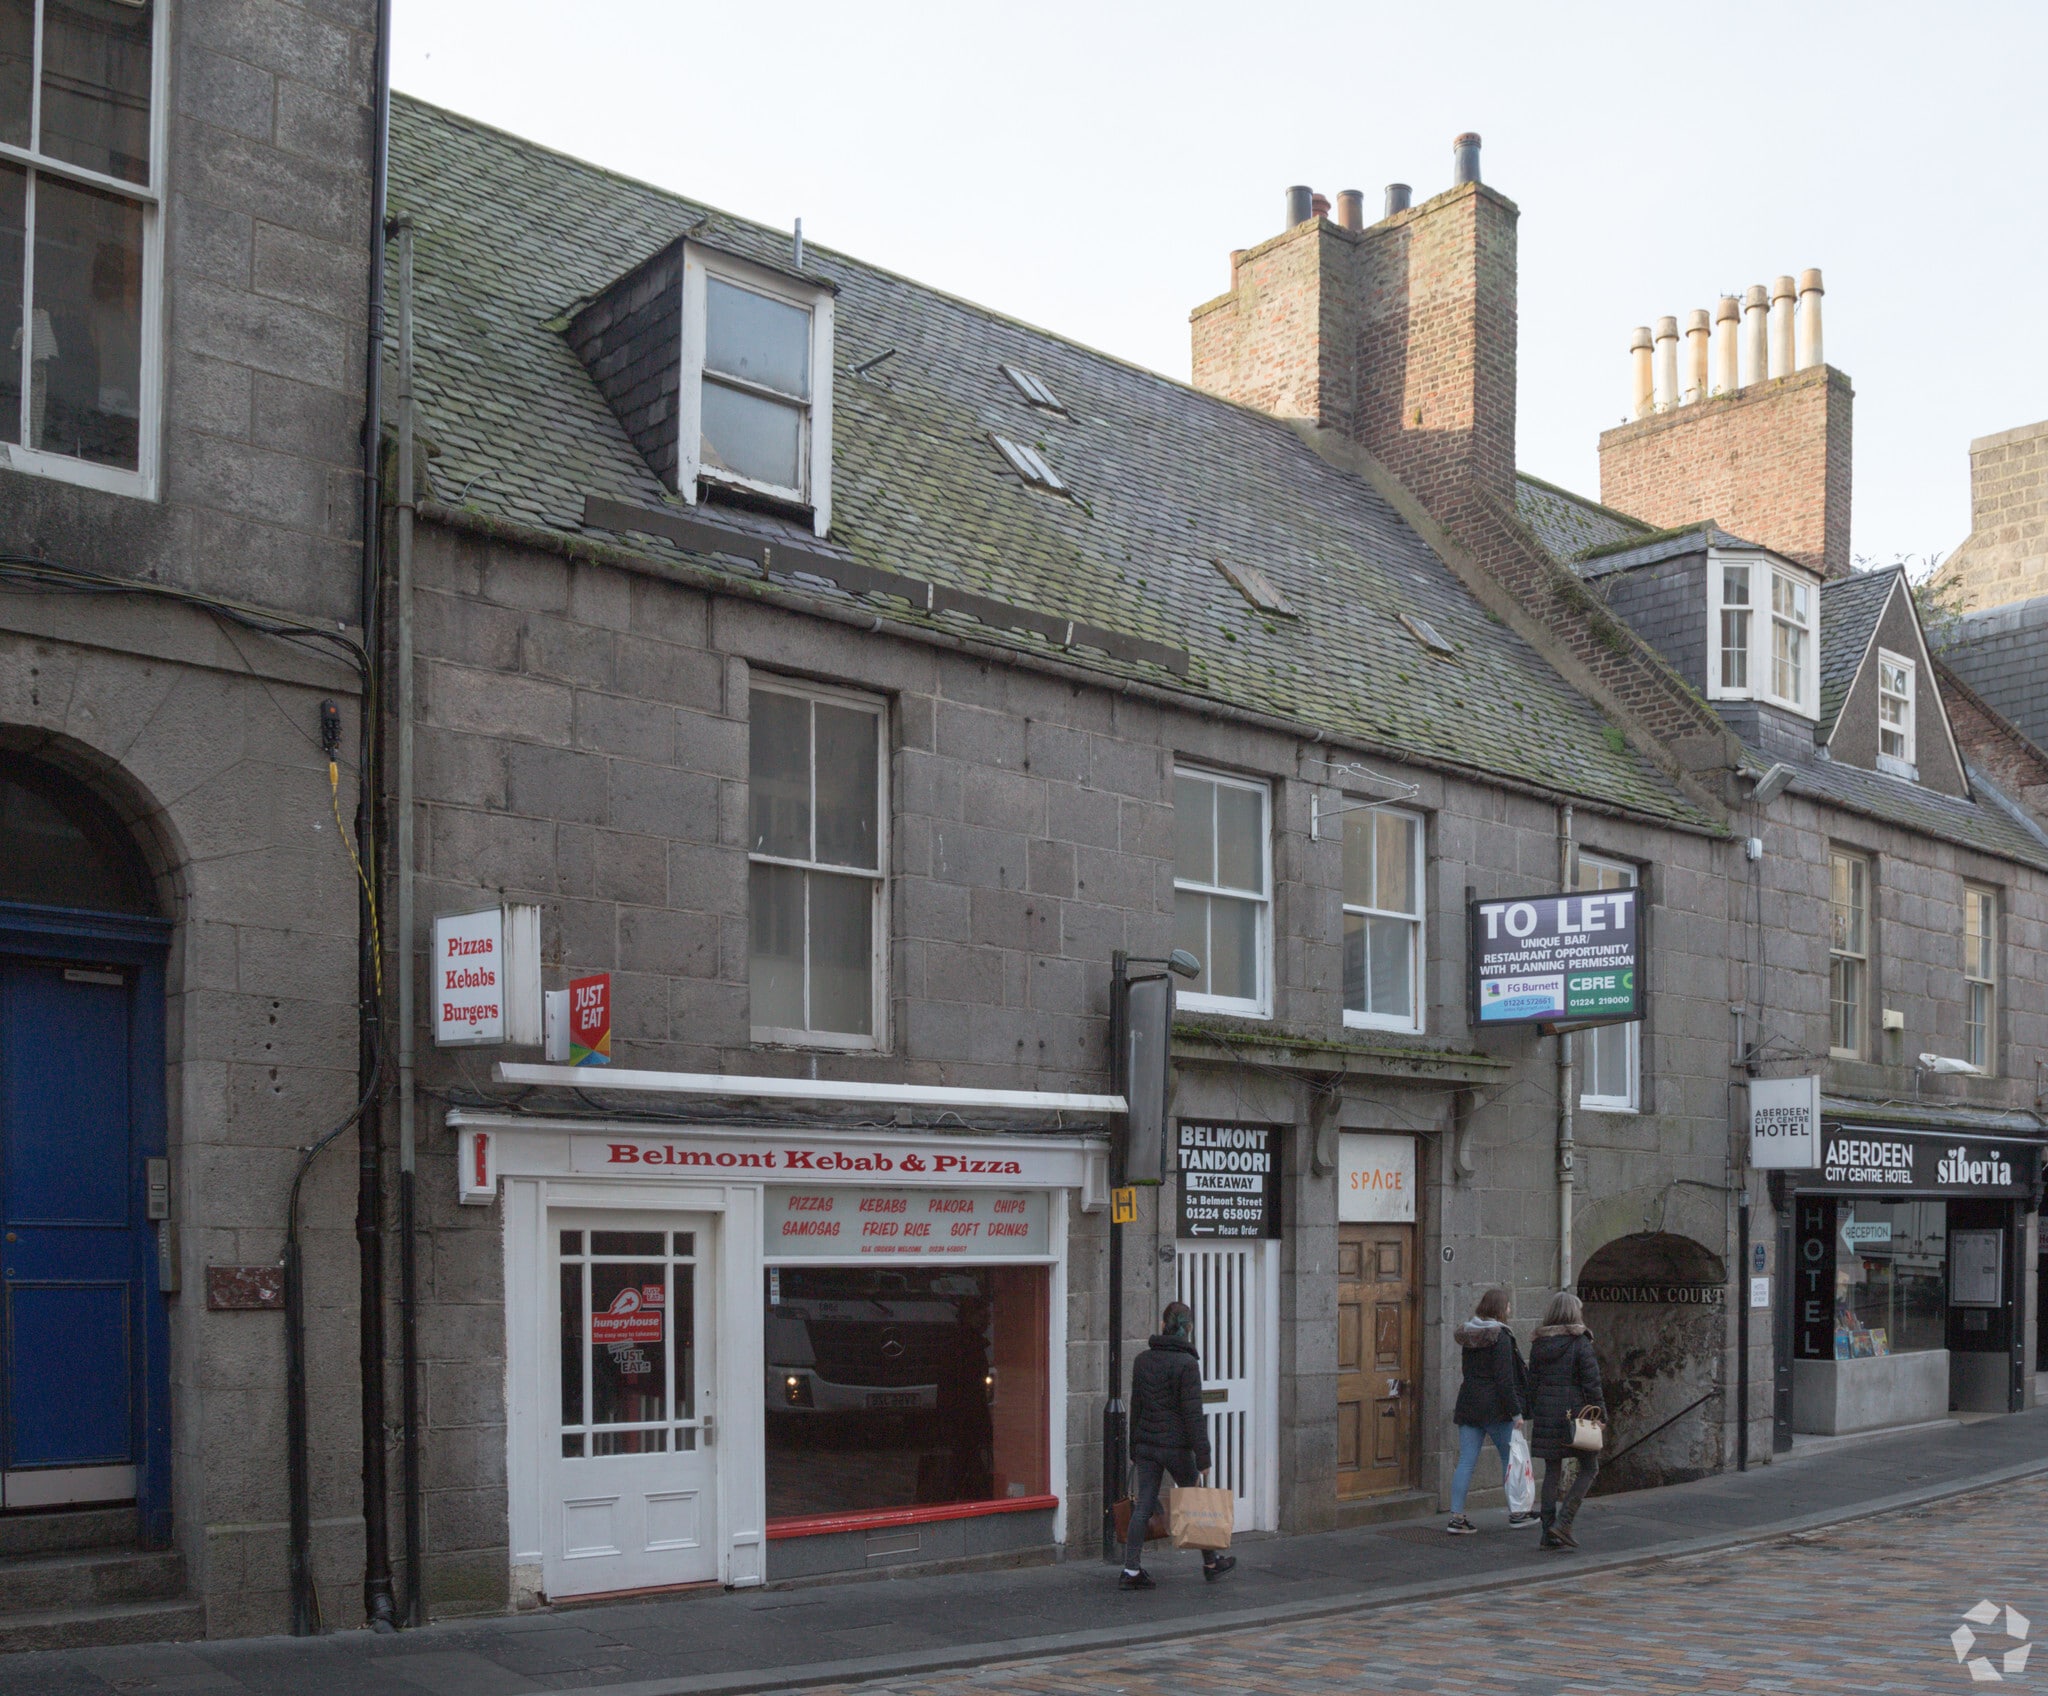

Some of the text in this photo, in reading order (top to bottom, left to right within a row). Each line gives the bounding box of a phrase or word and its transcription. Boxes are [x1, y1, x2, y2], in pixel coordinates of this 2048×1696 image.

[1480, 894, 1633, 939] TO LET
[448, 936, 494, 957] Pizzas
[1522, 934, 1590, 948] UNIQUE BAR/
[1484, 944, 1629, 964] RESTAURANT OPPORTUNITY
[1480, 955, 1634, 975] WITH PLANNING PERMISSION
[446, 966, 496, 990] Kebabs
[1570, 976, 1616, 990] CBRE
[1508, 982, 1559, 992] FG Burnett
[576, 984, 604, 1011] JUST
[1504, 999, 1525, 1007] 01224
[1570, 998, 1594, 1006] 01224
[443, 1002, 498, 1026] Burgers
[581, 1006, 604, 1030] EAT
[1755, 1108, 1809, 1117] ABERDEEN
[1777, 1116, 1808, 1124] CENTRE
[1181, 1126, 1268, 1149] BELMONT
[1756, 1124, 1809, 1137] HOTEL
[607, 1144, 1022, 1174] Belmont Kebab & Pizza
[1178, 1149, 1270, 1172] TANDOORI
[1826, 1140, 1913, 1168] ABERDEEN
[1938, 1146, 2012, 1186] siberia
[1196, 1176, 1254, 1190] TAKEAWAY
[1350, 1168, 1402, 1190] SPACE
[1826, 1167, 1912, 1184] CITY CENTRE HOTEL
[788, 1196, 1025, 1213] PIZZAS KEBABS PAKORA CHIPS
[1116, 1190, 1133, 1220] H
[1186, 1195, 1262, 1206] 5a Belmont Street
[1186, 1208, 1262, 1220] 01224 658057
[782, 1221, 1028, 1236] SAMOSAS FRIED RICE SOFT DRINKS
[1218, 1225, 1258, 1236] Please Order
[1846, 1226, 1888, 1238] RECEPTION
[1445, 1249, 1452, 1260] 7
[1804, 1208, 1824, 1354] HOTEL
[1668, 1288, 1724, 1304] COURT
[594, 1316, 659, 1329] hungryhouse
[615, 1350, 643, 1362] JUST
[622, 1362, 643, 1372] EAT
